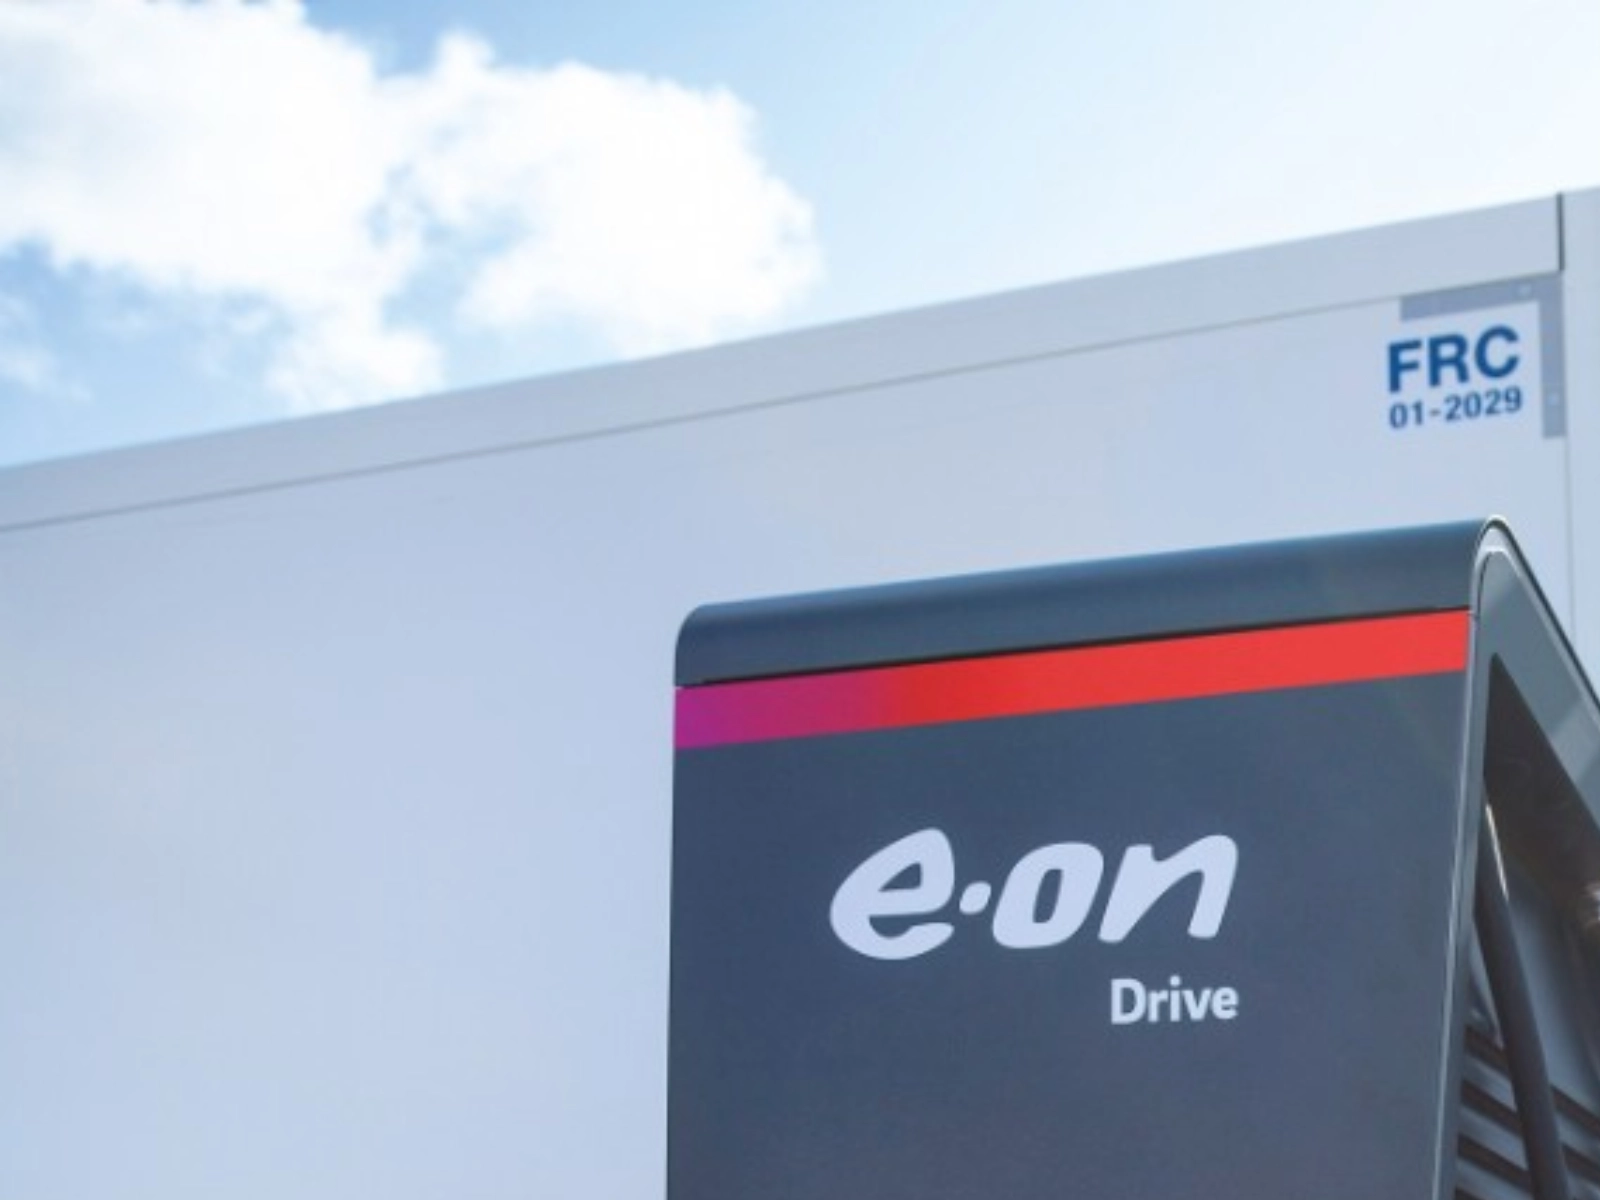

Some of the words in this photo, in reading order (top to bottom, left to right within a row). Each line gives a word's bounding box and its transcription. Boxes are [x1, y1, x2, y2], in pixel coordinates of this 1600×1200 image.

[1387, 323, 1520, 394] FRC
[1389, 386, 1523, 430] 01-2029
[1110, 976, 1239, 1025] Drive
